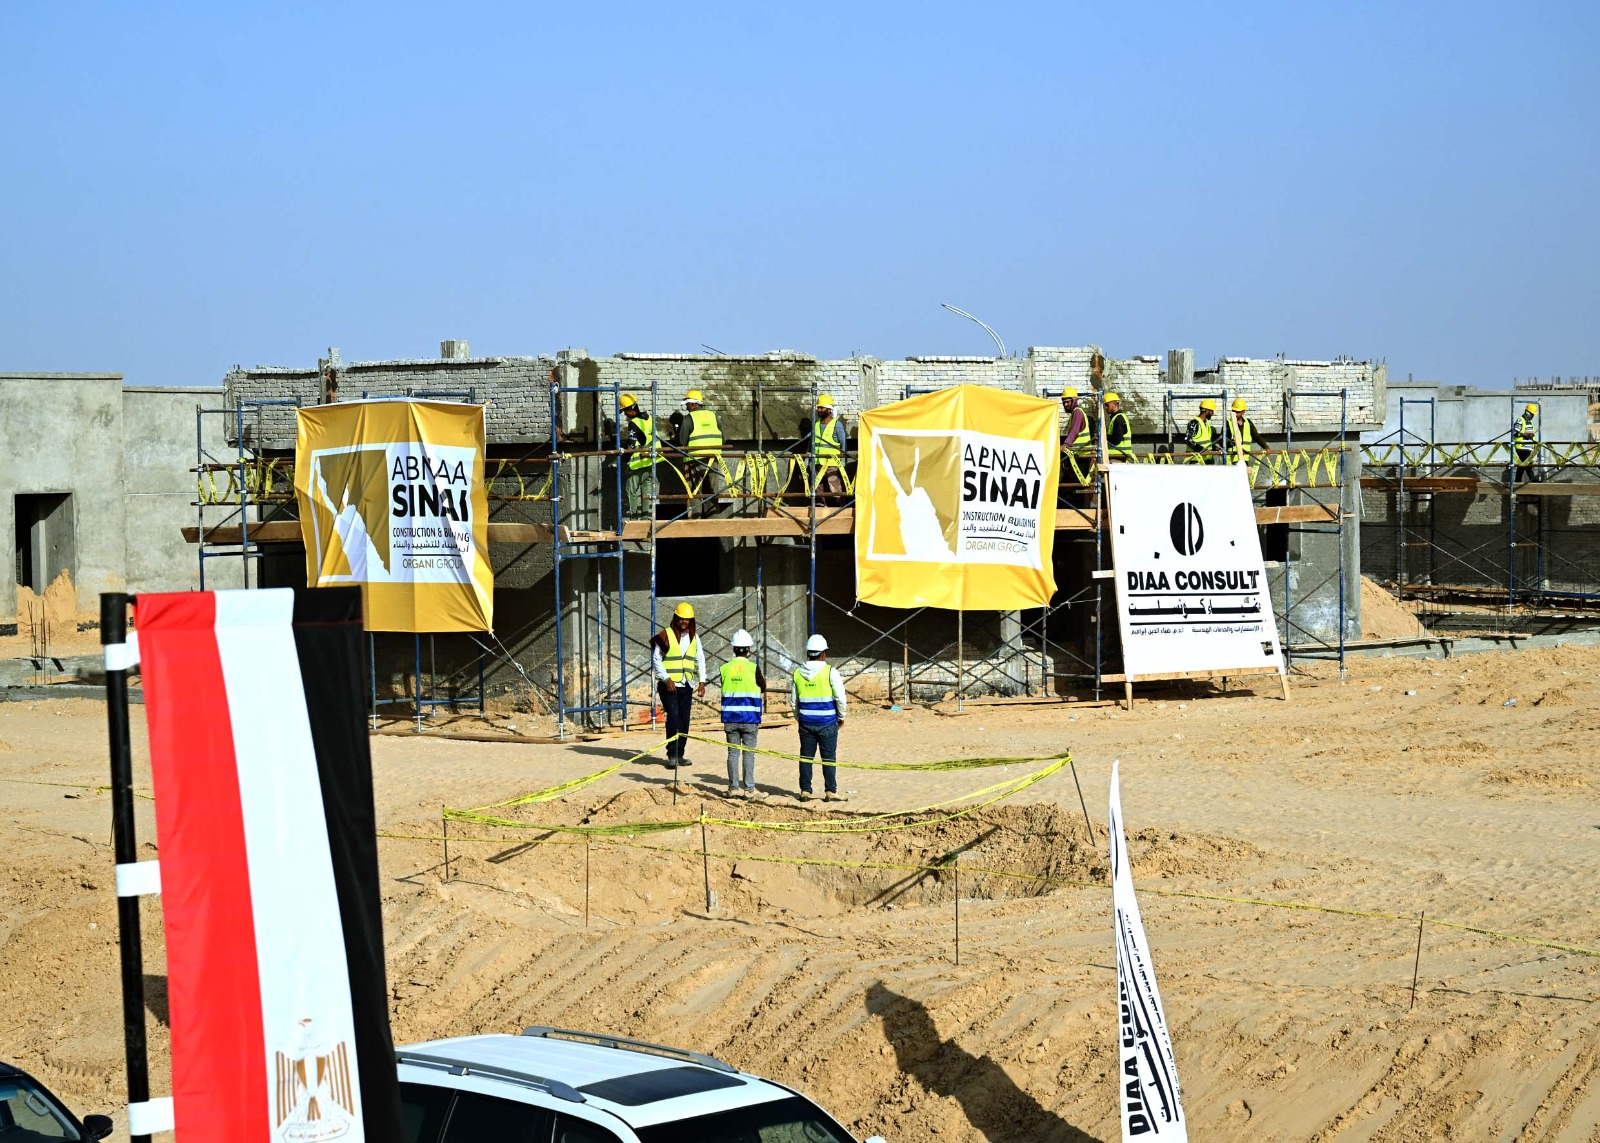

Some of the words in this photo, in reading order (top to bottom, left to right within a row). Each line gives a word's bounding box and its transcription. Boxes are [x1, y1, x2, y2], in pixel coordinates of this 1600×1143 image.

[391, 455, 468, 486] ABNAA
[392, 483, 469, 522] SINAI
[963, 470, 1040, 510] SINAI
[392, 527, 436, 538] CONSTRUCTION
[437, 527, 442, 538] &
[965, 540, 996, 551] ORGANI
[997, 541, 1028, 554] GROP
[402, 558, 434, 569] ORGANI
[1127, 571, 1171, 590] DIAA
[1174, 570, 1260, 590] CONSULT
[1124, 1055, 1151, 1137] DIAA
